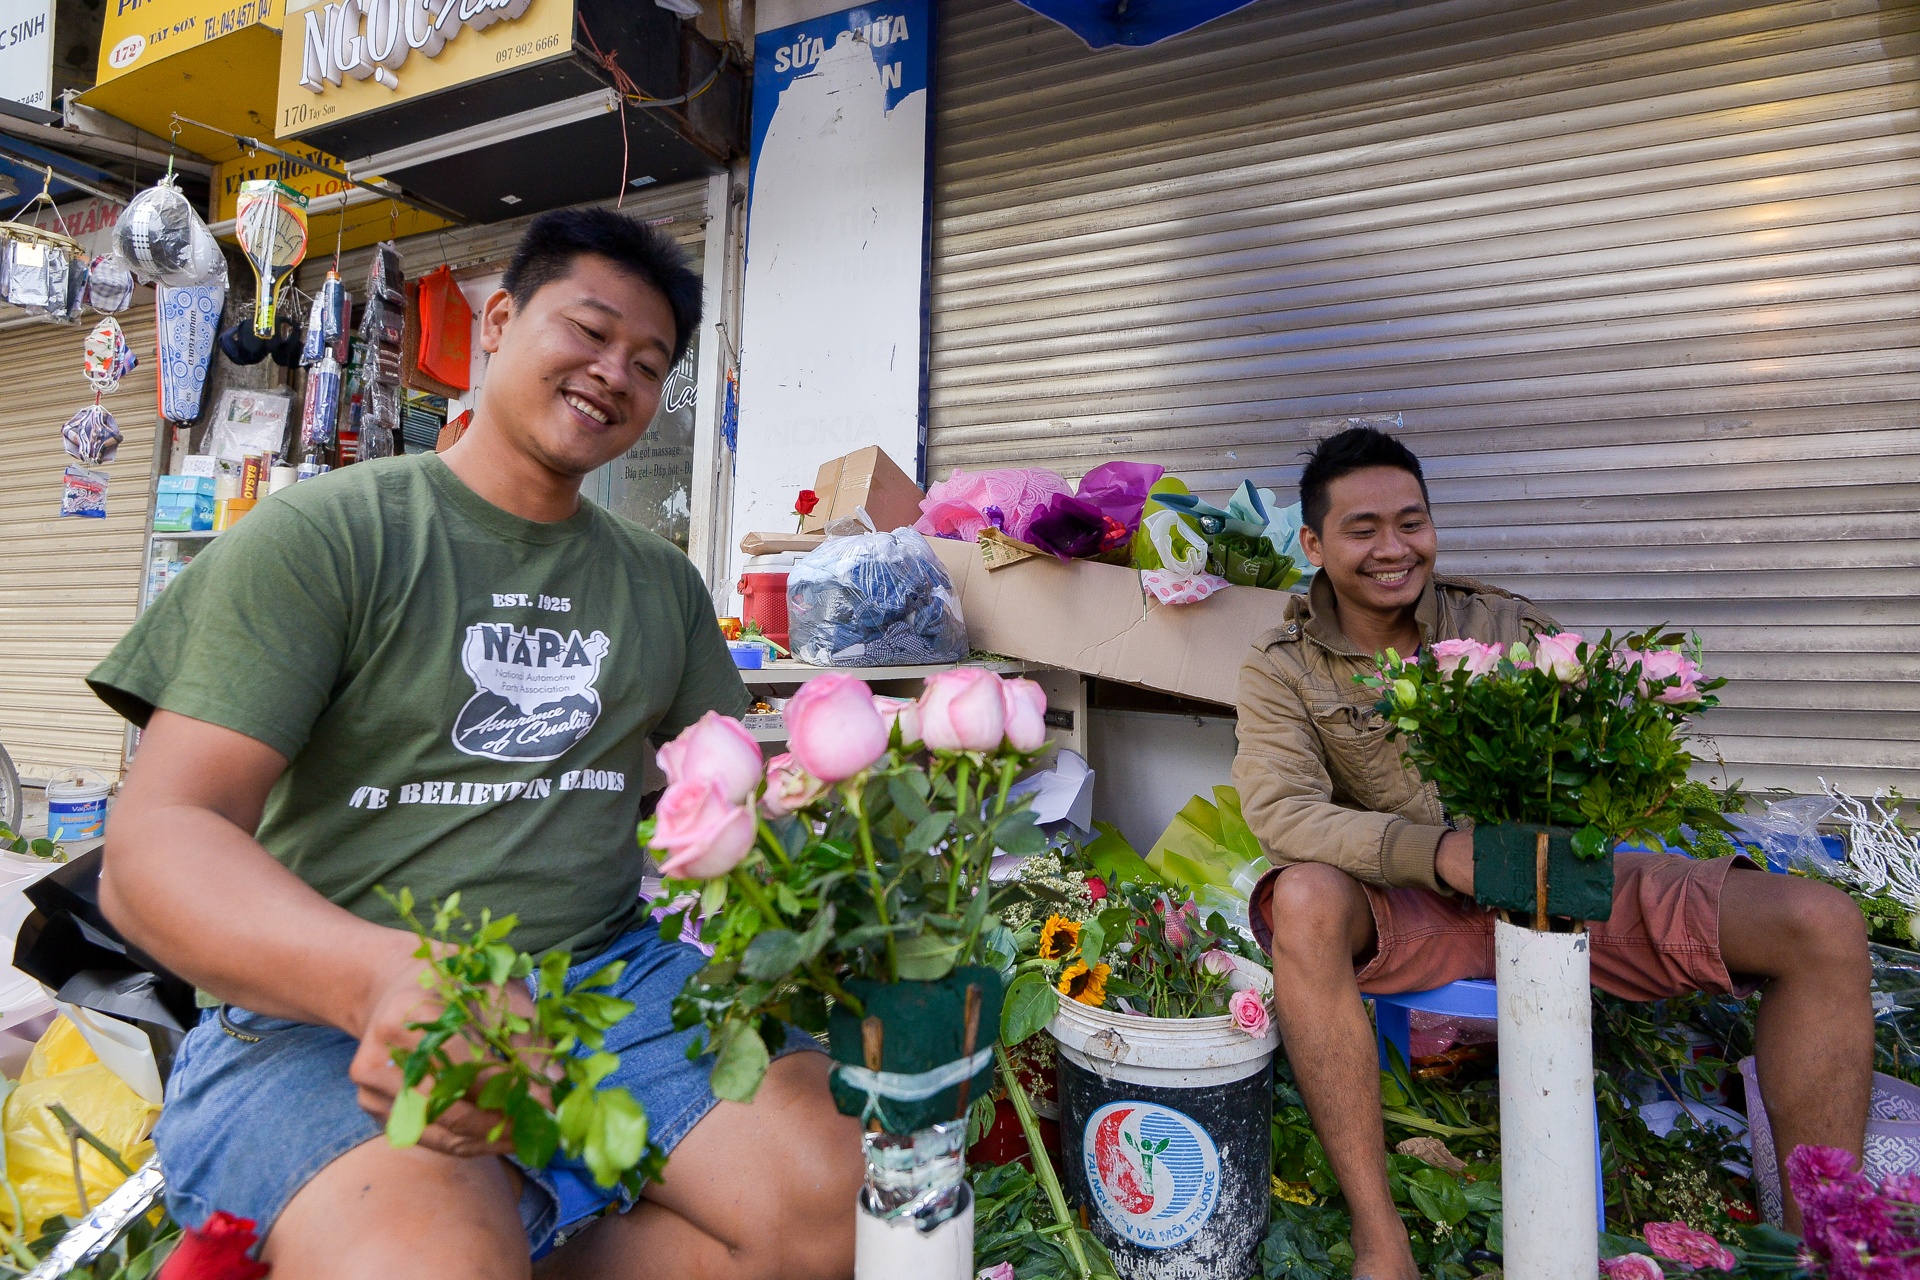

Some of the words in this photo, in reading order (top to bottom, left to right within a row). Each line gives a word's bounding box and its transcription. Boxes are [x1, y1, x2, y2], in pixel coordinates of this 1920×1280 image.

[10, 13, 45, 46] SINH
[149, 27, 170, 45] TÂY
[172, 15, 198, 36] SƠN
[204, 16, 220, 41] TEL:
[220, 8, 236, 34] 043
[236, 2, 256, 29] 4571
[496, 49, 514, 64] 097
[515, 44, 533, 59] 992
[535, 33, 559, 53] 6666
[774, 33, 825, 73] SỬA
[283, 102, 307, 128] 170
[651, 445, 680, 458] massage
[491, 593, 534, 608] EST.
[537, 594, 572, 612] 1925
[495, 668, 525, 681] National
[525, 669, 576, 682] Automotive
[501, 681, 519, 692] Parts
[519, 683, 570, 694] Association
[459, 706, 566, 741] Assurance
[482, 728, 515, 753] of
[516, 708, 593, 745] Quality
[349, 785, 390, 810] WE
[522, 778, 553, 800] IN
[1136, 1226, 1157, 1242] VÀ
[1159, 1223, 1188, 1243] MÔI
